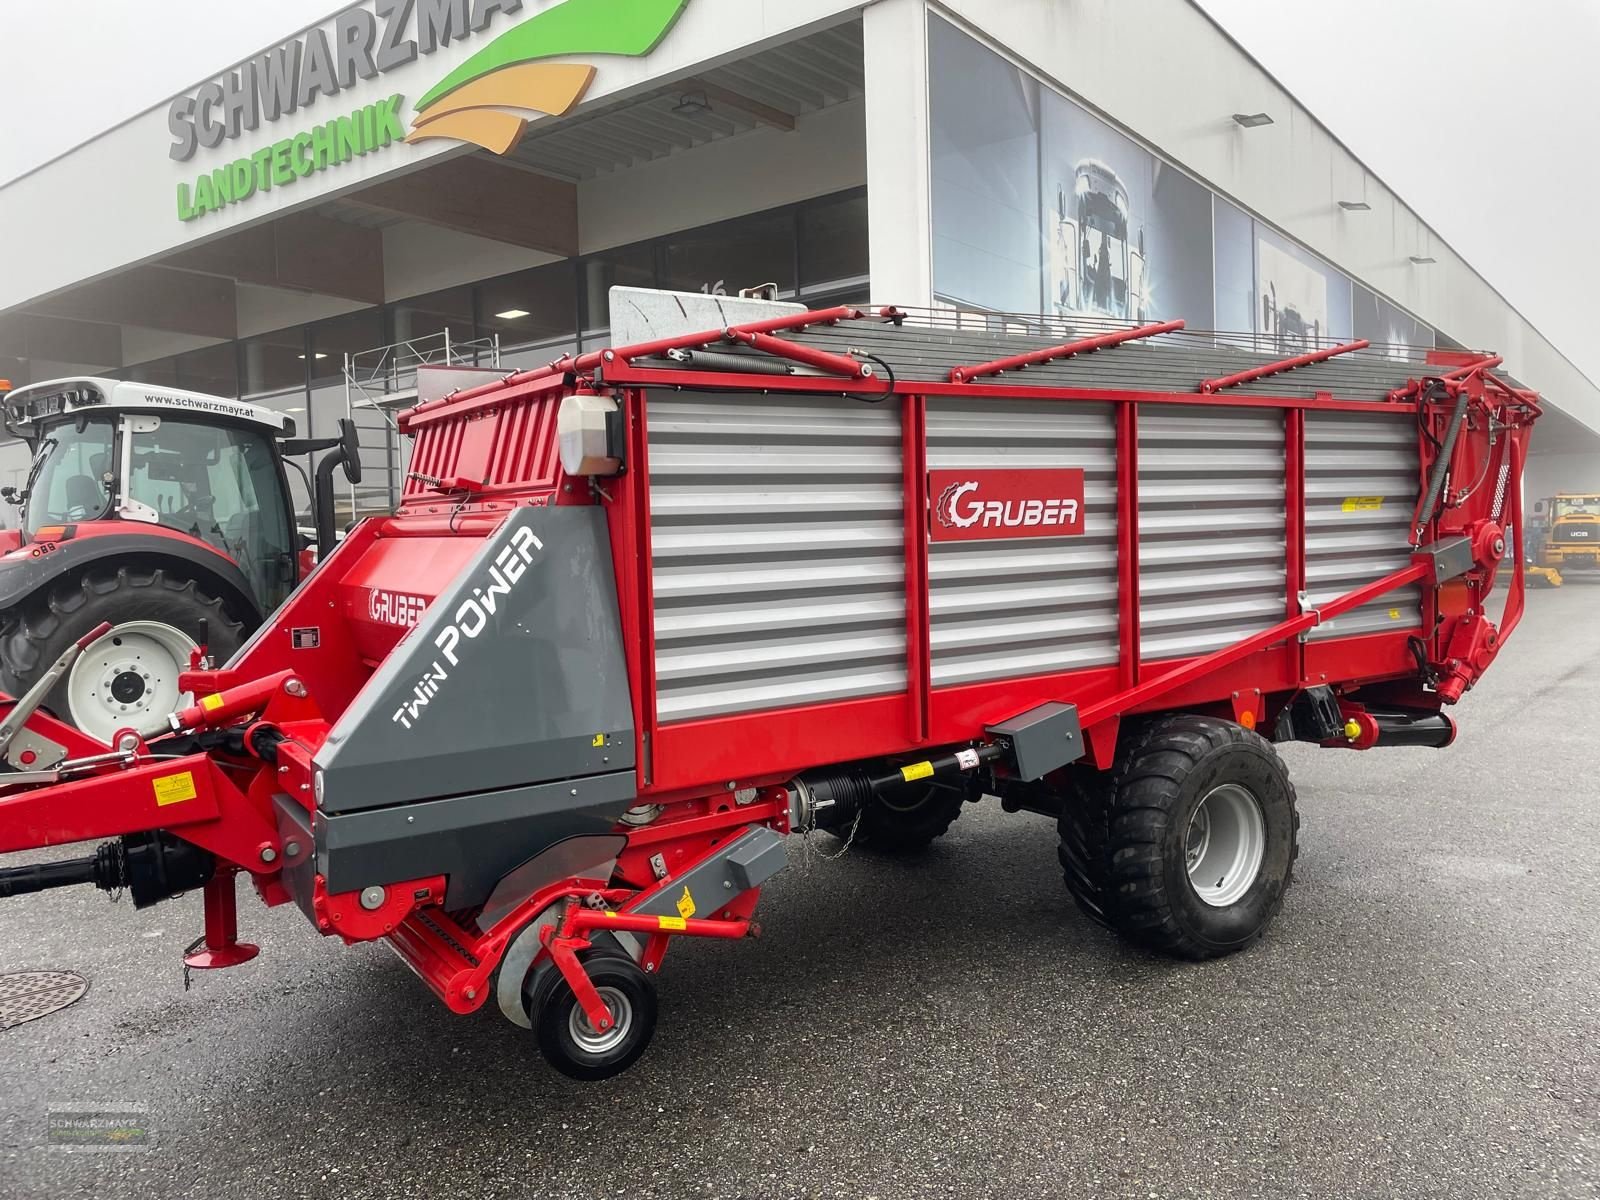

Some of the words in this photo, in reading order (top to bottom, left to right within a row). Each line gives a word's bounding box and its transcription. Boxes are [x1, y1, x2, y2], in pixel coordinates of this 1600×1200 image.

[177, 93, 406, 222] LANDTECHNIK
[145, 395, 254, 417] www.schwarzmayr.at
[948, 481, 1079, 528] GRUBER
[434, 525, 544, 667] POWER
